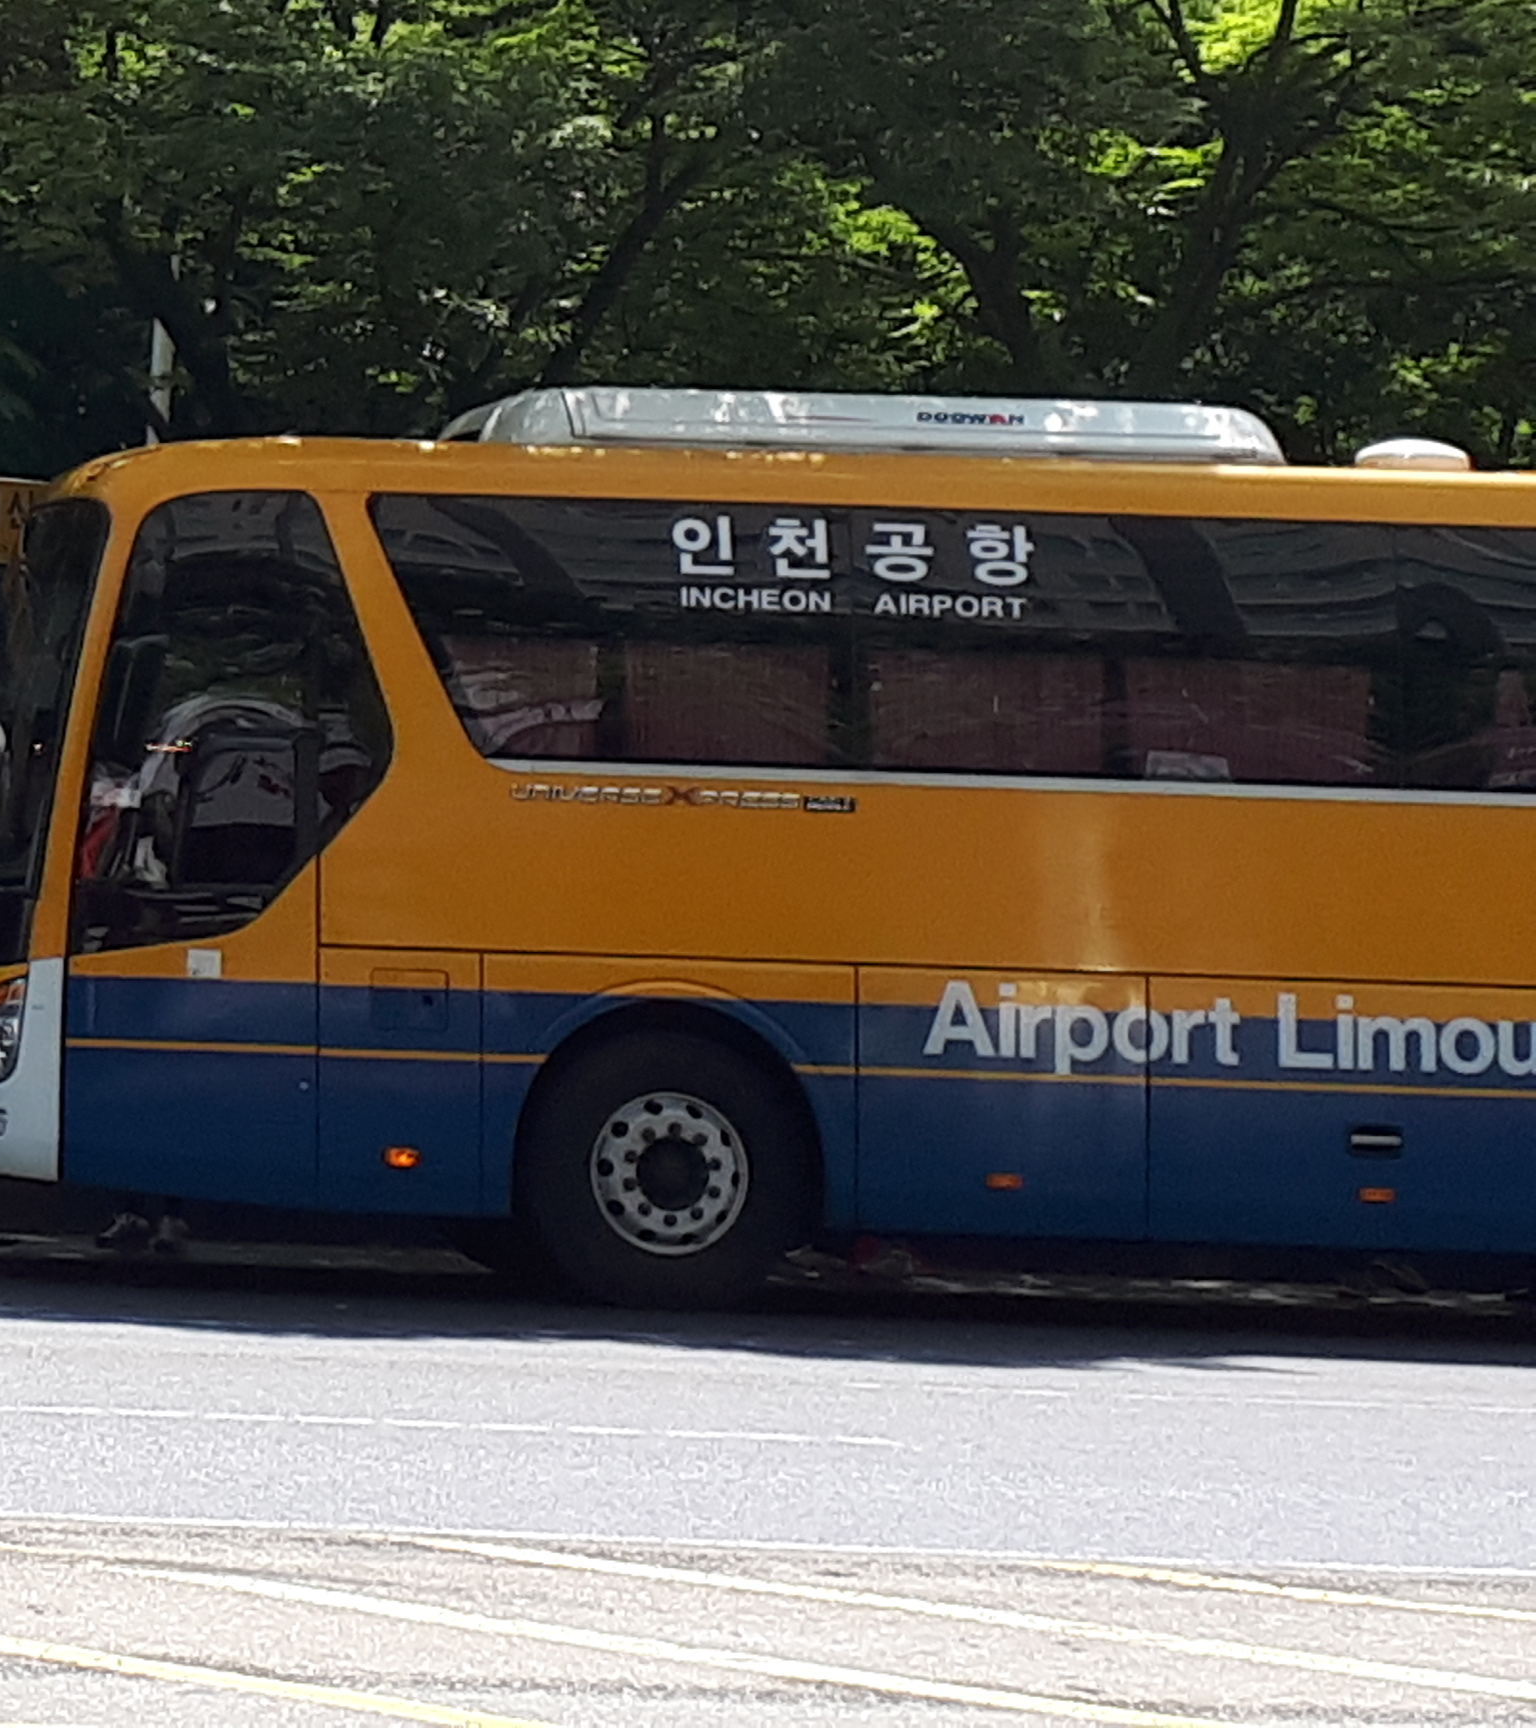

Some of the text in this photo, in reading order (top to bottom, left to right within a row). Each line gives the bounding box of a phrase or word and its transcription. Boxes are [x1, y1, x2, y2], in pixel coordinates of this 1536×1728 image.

[679, 585, 1027, 620] INCHEON AIRPORT
[922, 979, 1241, 1076] Airport
